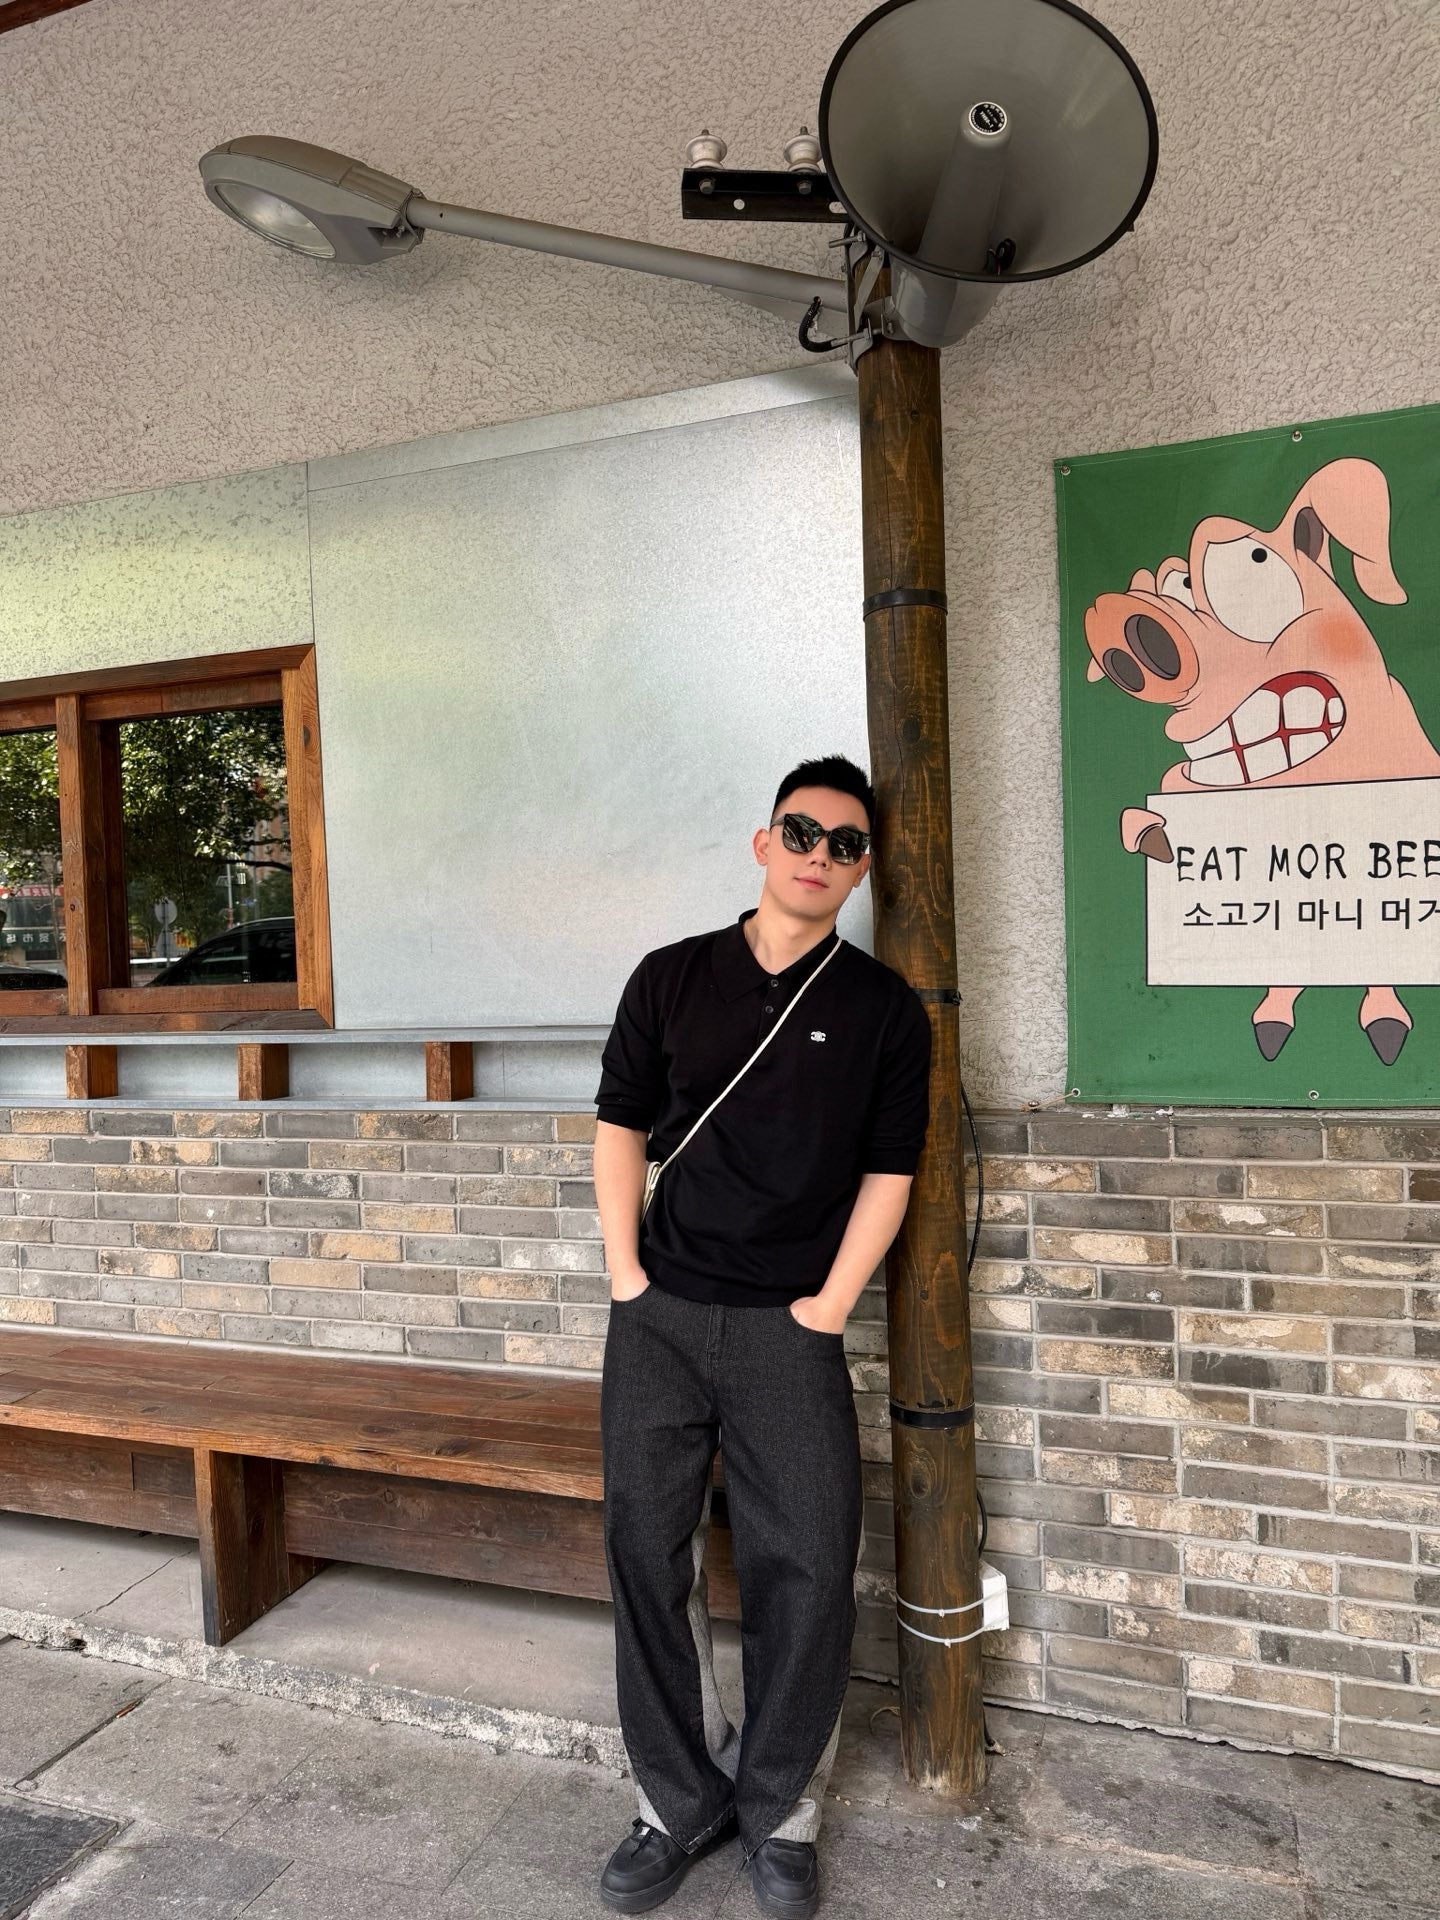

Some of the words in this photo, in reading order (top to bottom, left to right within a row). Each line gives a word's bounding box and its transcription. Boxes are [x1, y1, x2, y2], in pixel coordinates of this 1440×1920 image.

[1176, 845, 1248, 882] EAT
[1268, 842, 1347, 882] MOR
[1182, 899, 1280, 931] 소고기
[1298, 898, 1362, 931] 마니
